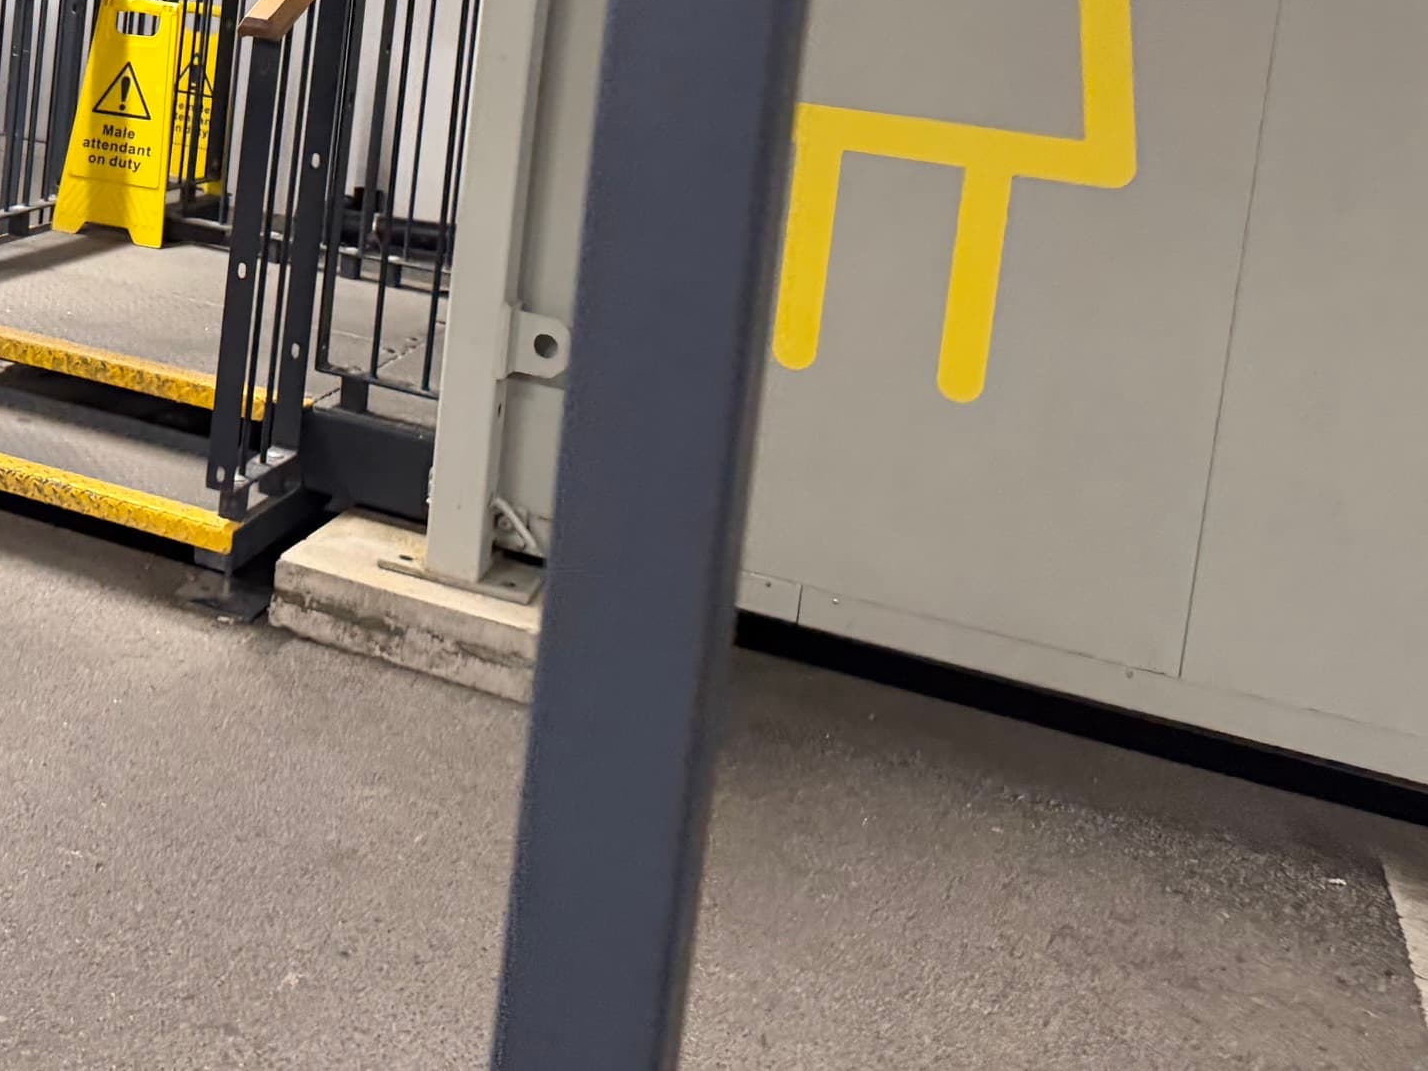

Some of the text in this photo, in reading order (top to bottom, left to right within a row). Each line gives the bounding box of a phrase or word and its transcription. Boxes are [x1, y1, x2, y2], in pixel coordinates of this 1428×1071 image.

[102, 124, 136, 139] Male
[83, 137, 151, 157] attendant
[88, 154, 141, 173] on duty
